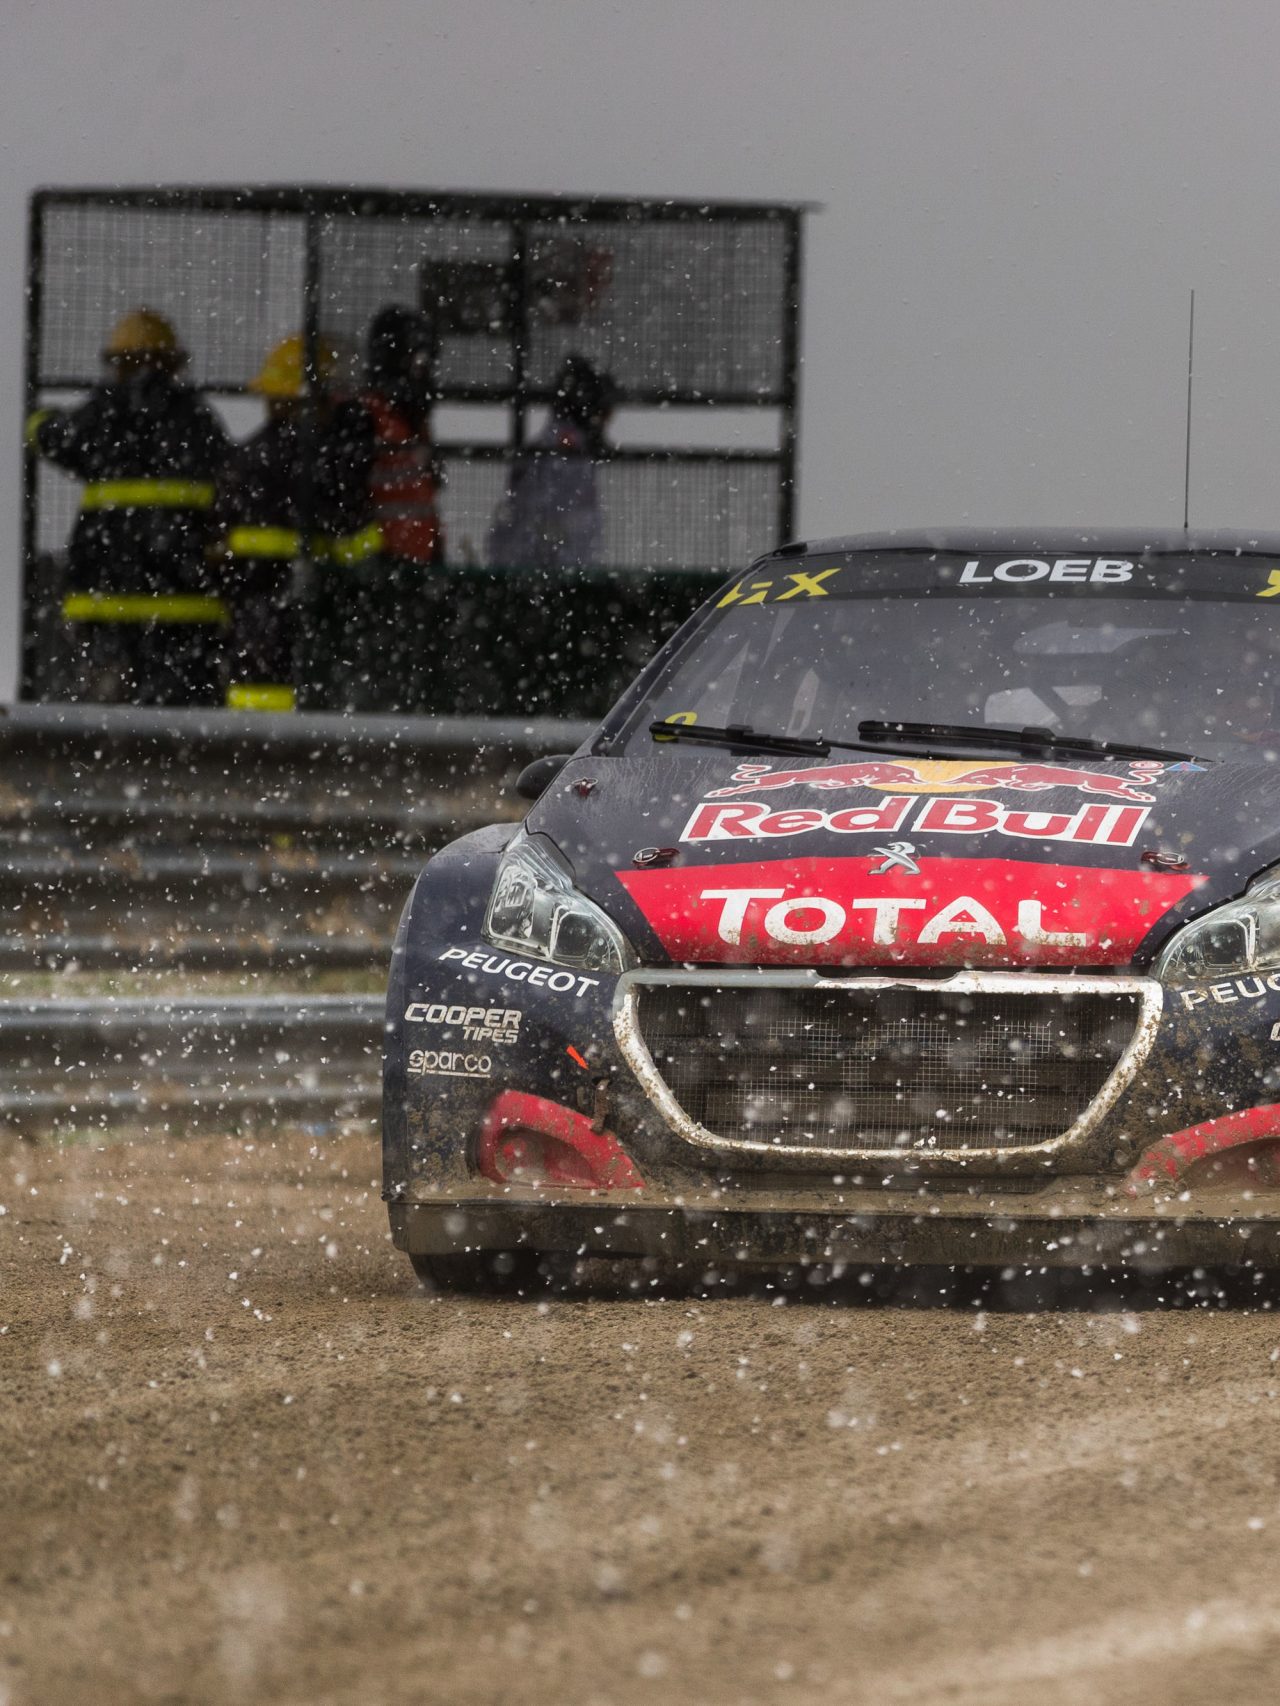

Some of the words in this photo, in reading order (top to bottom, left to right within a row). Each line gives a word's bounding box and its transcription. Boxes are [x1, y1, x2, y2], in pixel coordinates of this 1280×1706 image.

[959, 559, 1134, 582] LOEB
[680, 796, 917, 842] Red
[910, 799, 1152, 847] Bull
[700, 888, 1086, 946] TOTAL
[438, 948, 600, 998] PEUGEOT
[404, 1002, 522, 1029] COOPER
[408, 1049, 492, 1076] sparco
